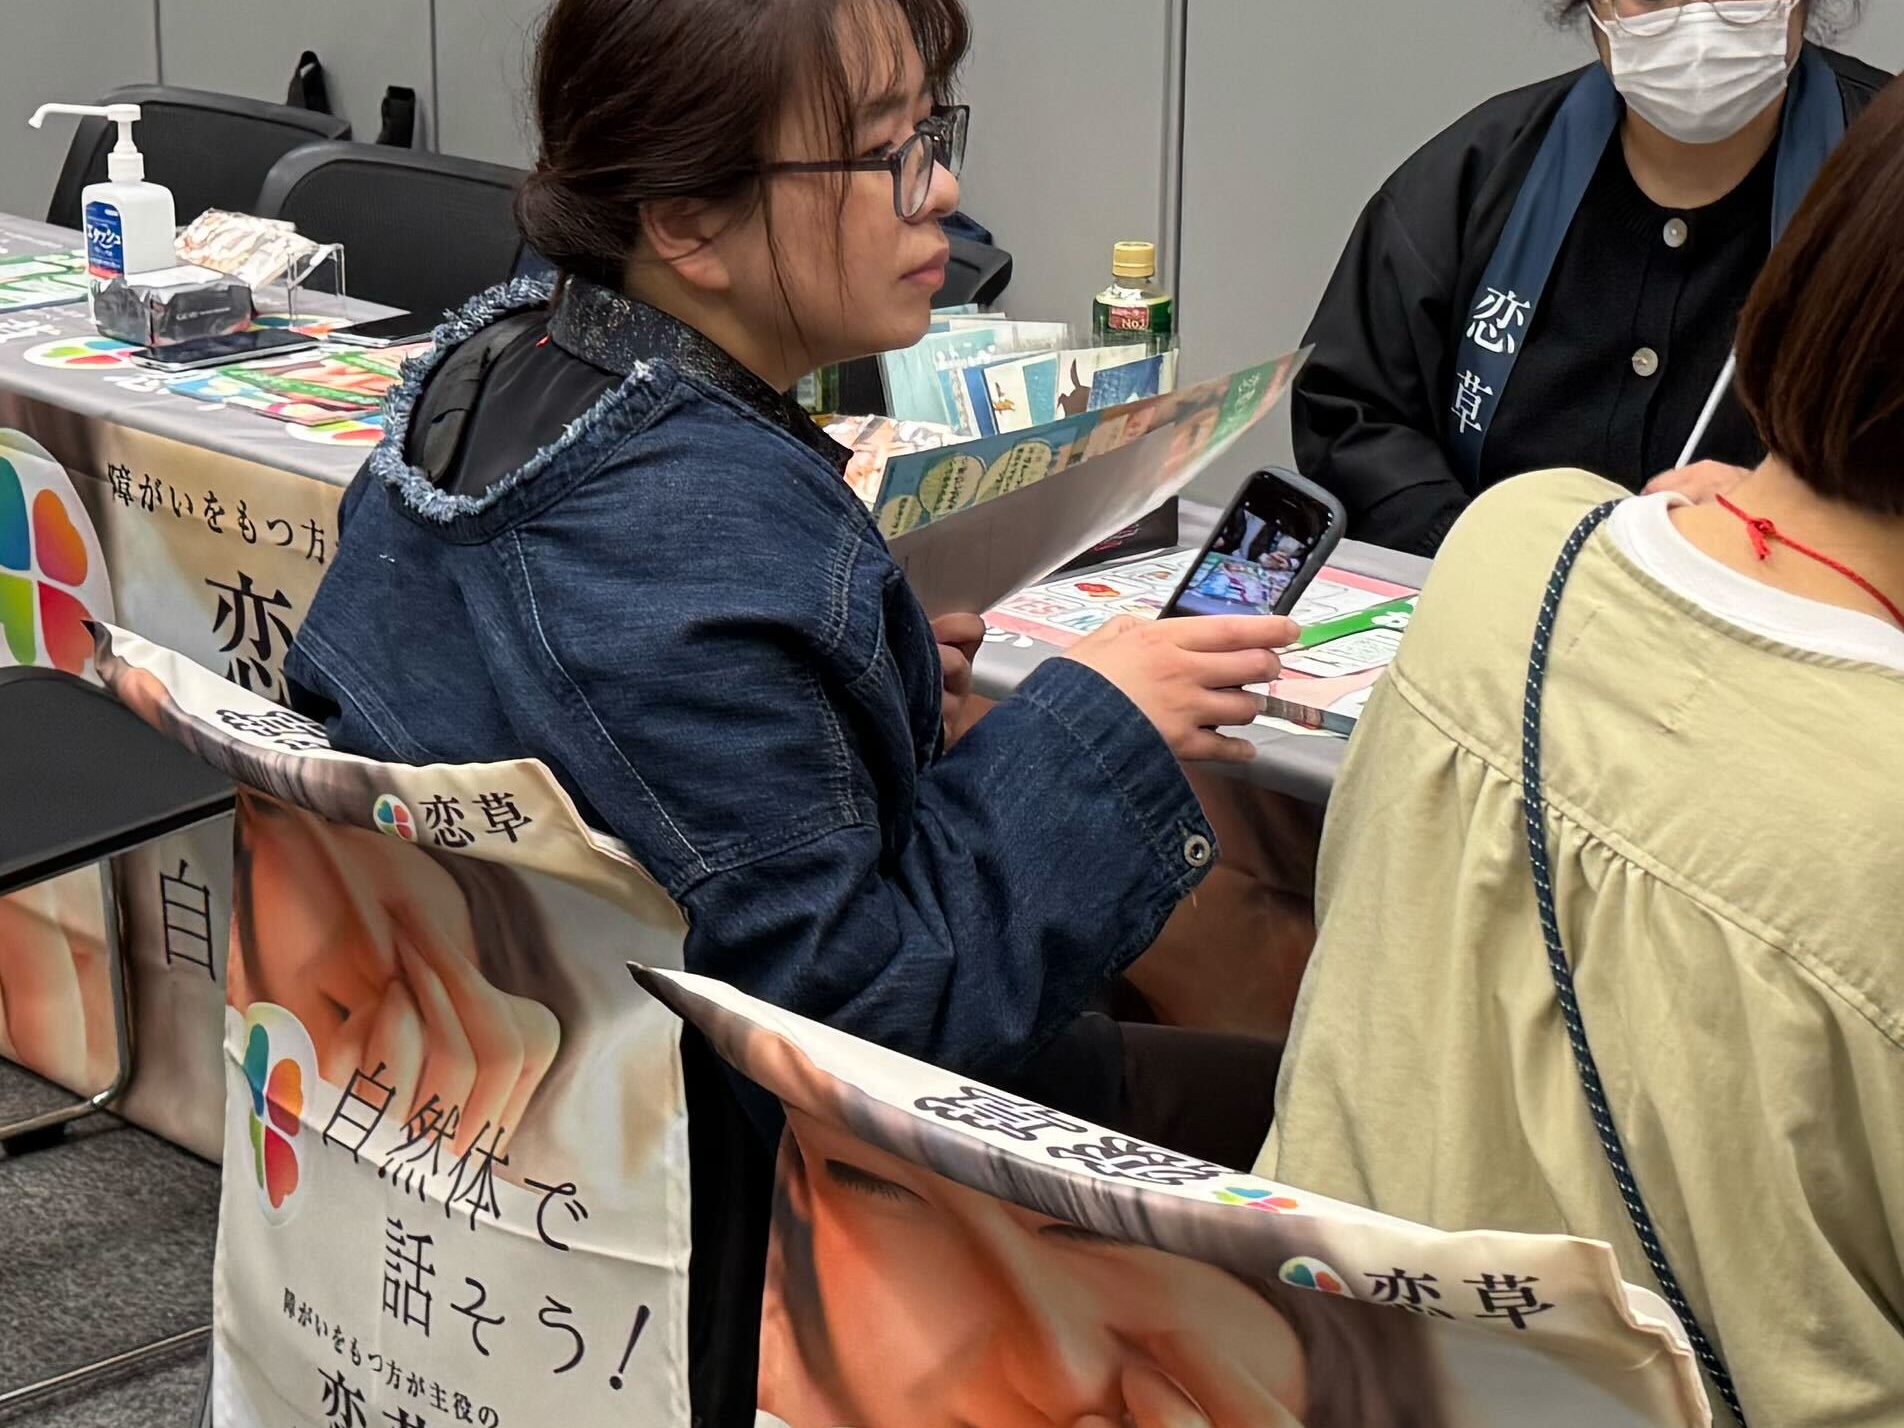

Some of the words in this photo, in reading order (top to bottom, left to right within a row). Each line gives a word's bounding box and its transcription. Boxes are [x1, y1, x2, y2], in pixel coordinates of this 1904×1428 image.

[1450, 286, 1532, 434] 恋草
[107, 461, 340, 565] 障がいをもつ方
[418, 791, 534, 851] 恋草
[158, 858, 217, 982] 自
[320, 1060, 590, 1254] 自然体で
[382, 1216, 651, 1391] 話そう！
